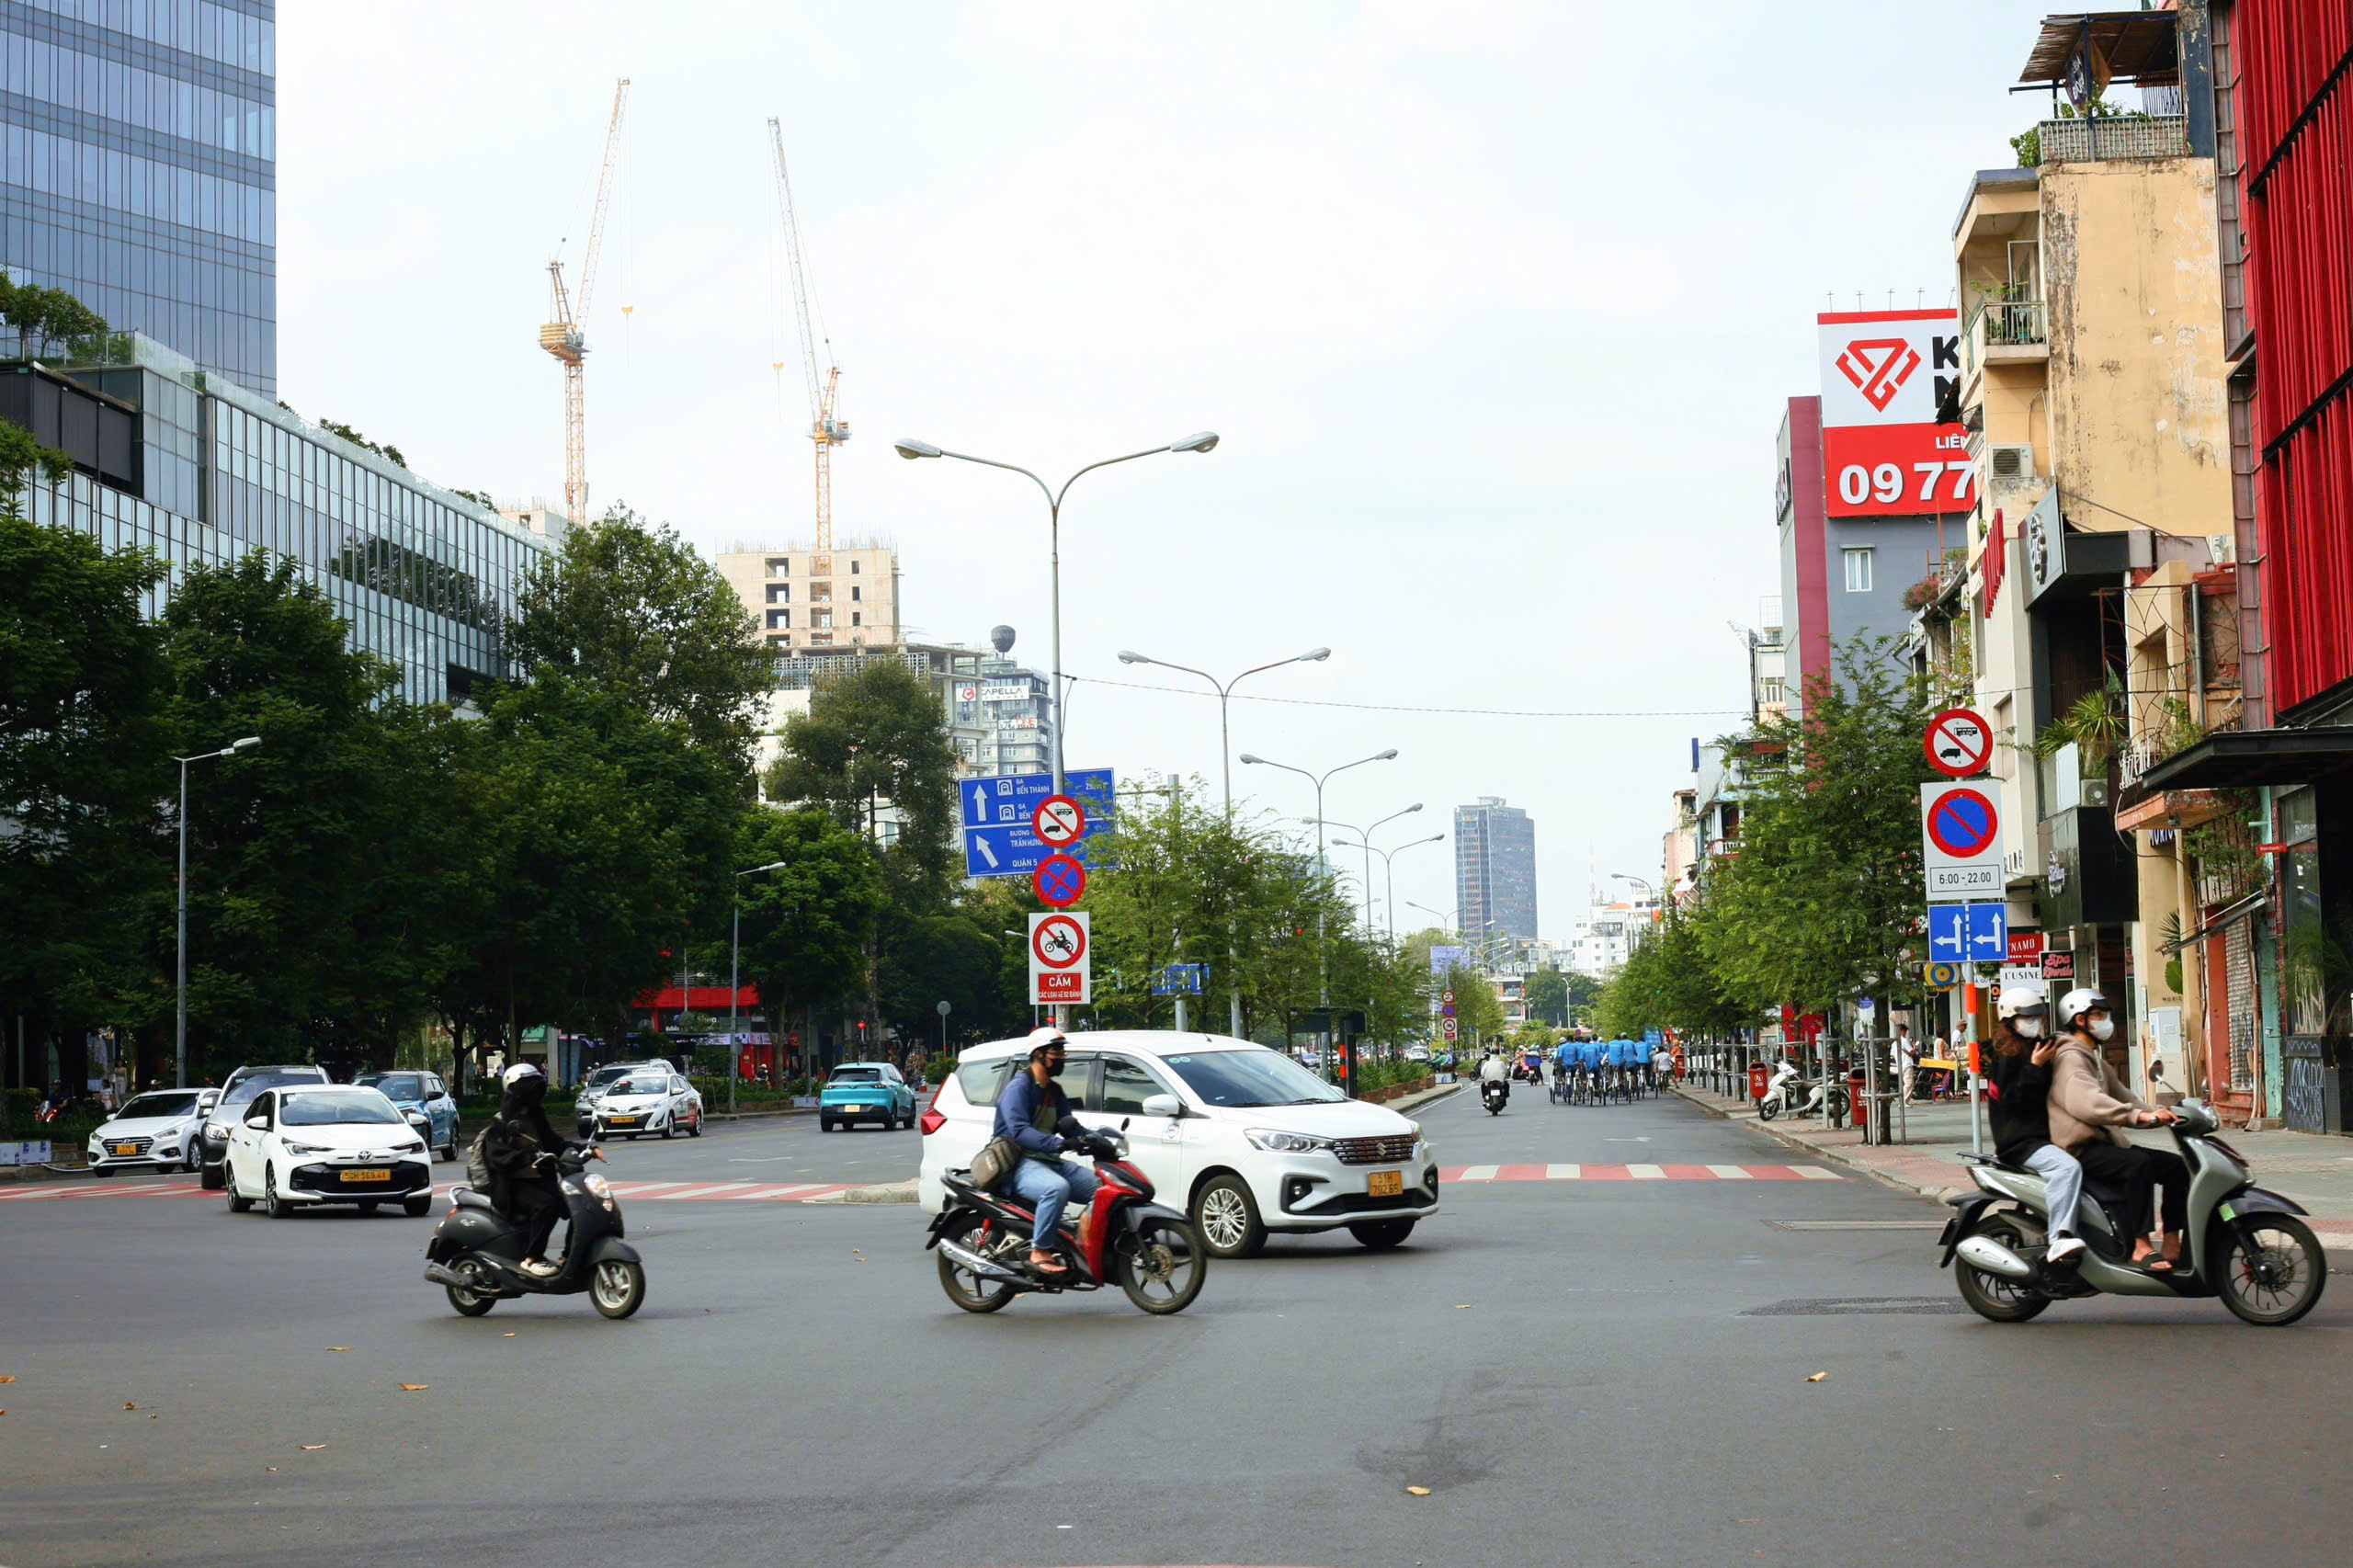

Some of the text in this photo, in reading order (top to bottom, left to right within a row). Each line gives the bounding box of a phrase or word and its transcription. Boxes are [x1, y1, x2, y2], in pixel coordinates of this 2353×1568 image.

[1839, 463, 1904, 505] 09
[1914, 460, 1975, 501] 77
[1939, 873, 1959, 884] 6:00
[1967, 872, 1991, 883] 22:00
[2008, 938, 2035, 952] NAMO
[2044, 953, 2071, 967] Spa
[1049, 973, 1072, 987] CẤM
